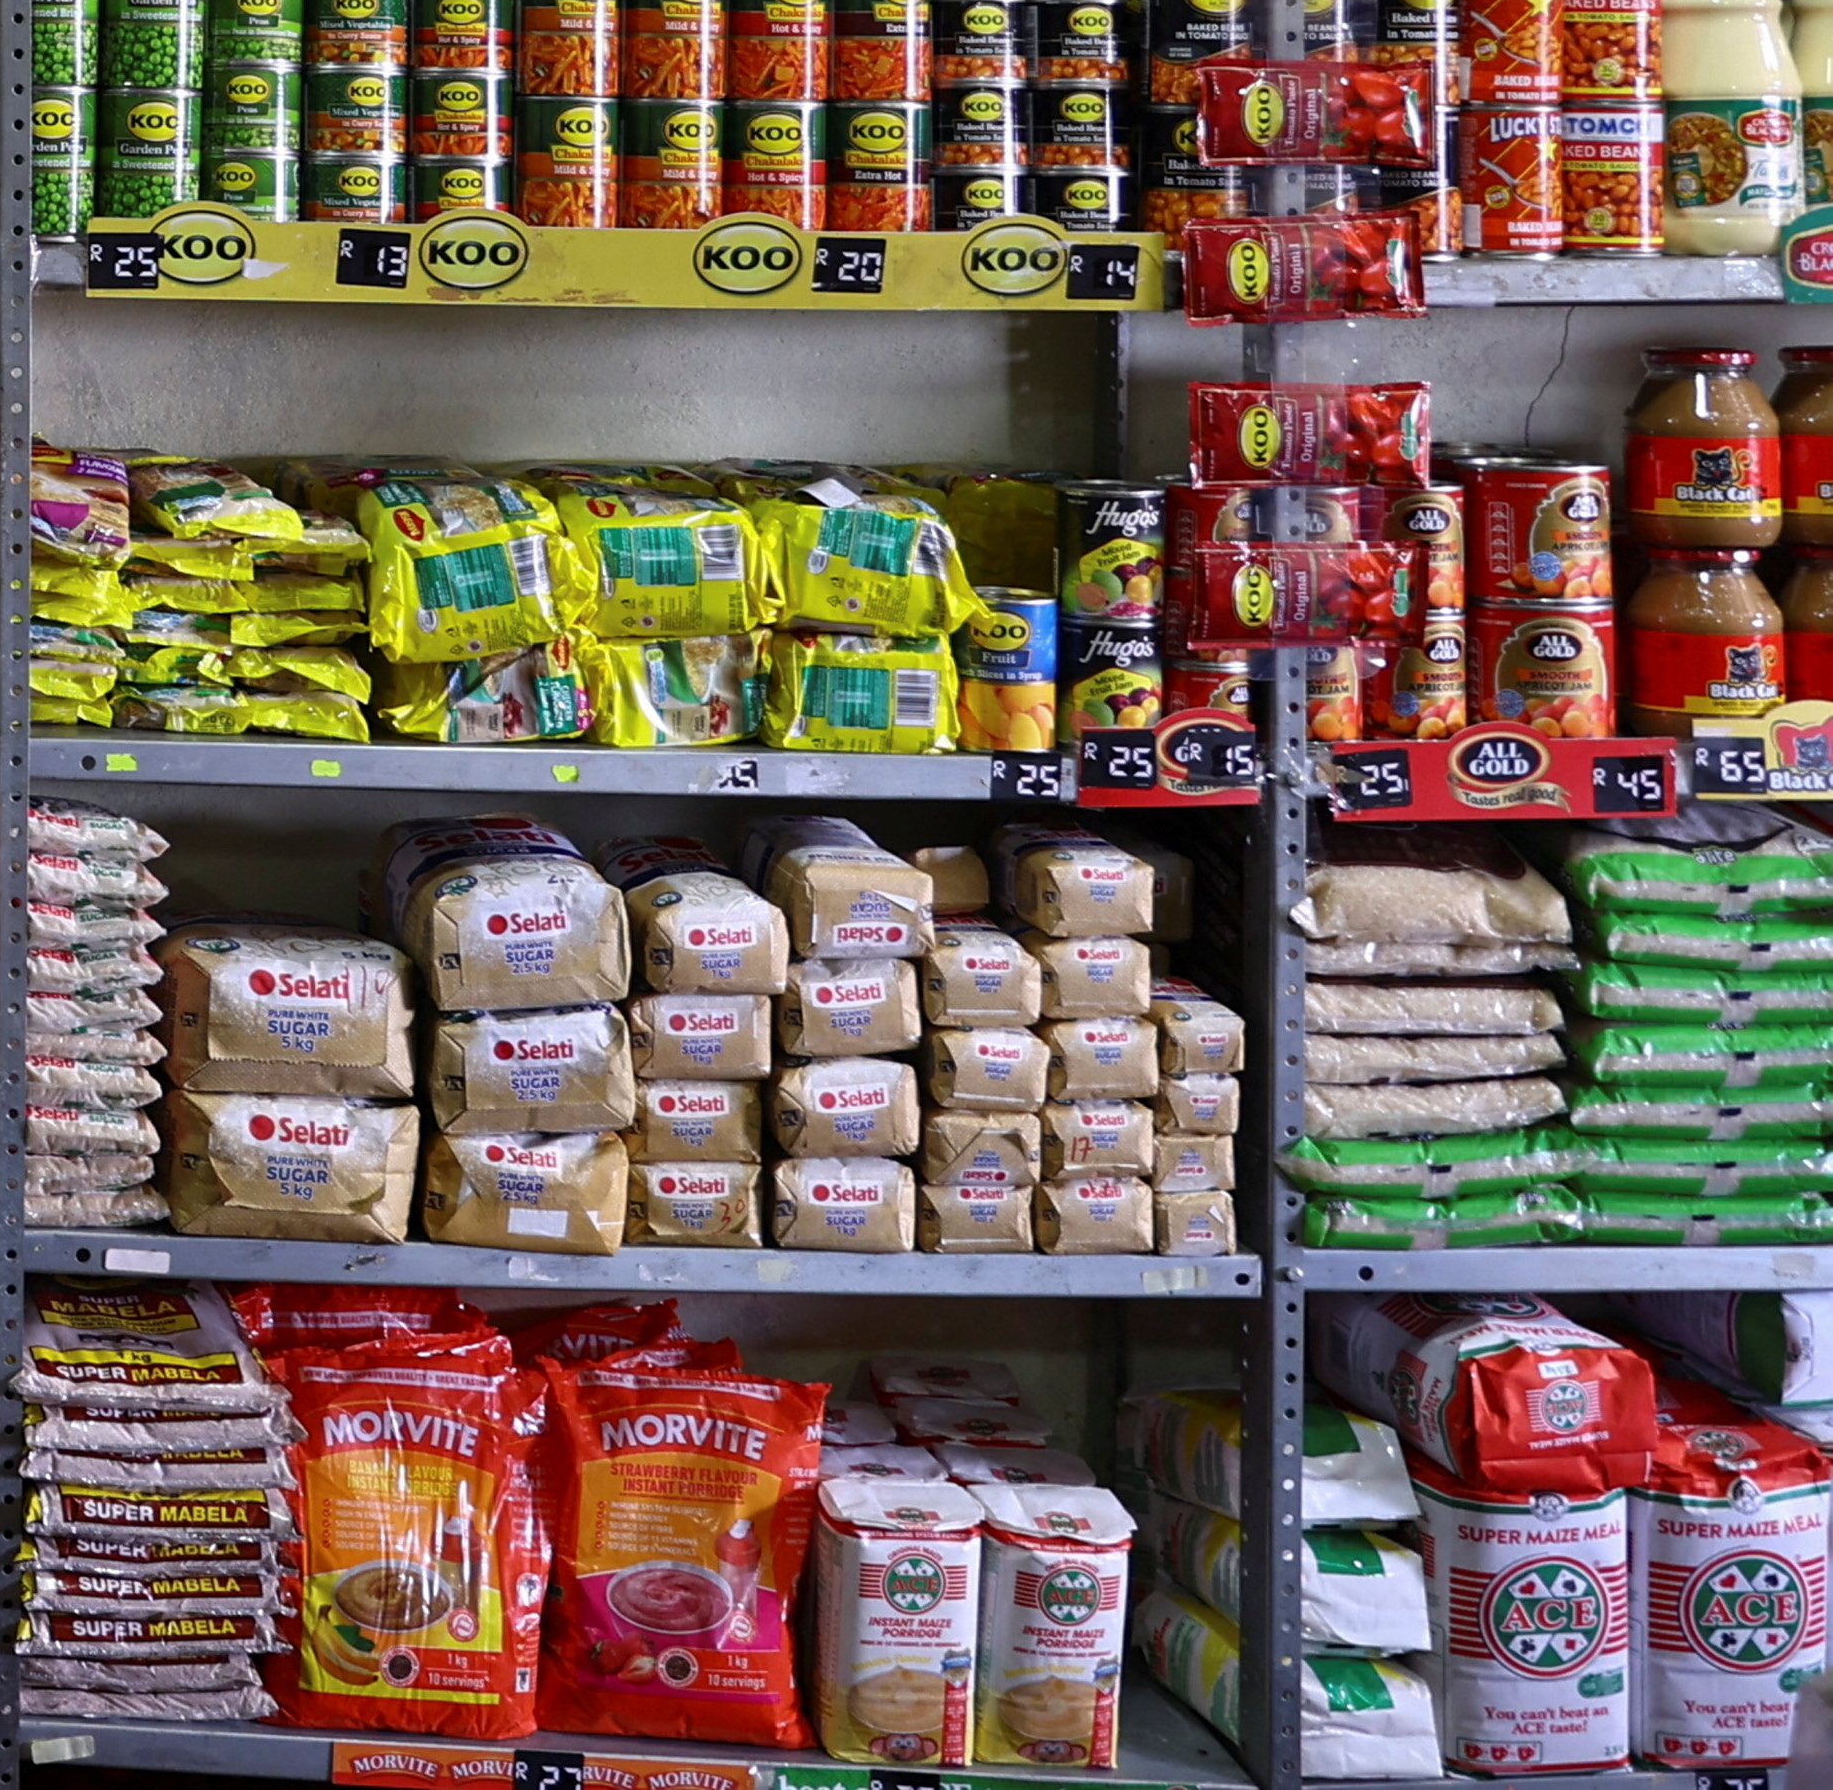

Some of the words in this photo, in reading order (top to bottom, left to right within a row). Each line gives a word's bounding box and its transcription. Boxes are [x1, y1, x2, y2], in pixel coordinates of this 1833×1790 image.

[855, 171, 879, 180] Extra
[882, 171, 902, 181] Hot
[115, 248, 158, 278] 25
[377, 246, 407, 276] 13
[427, 240, 520, 268] KOO
[702, 245, 793, 272] KOO
[970, 247, 1059, 272] KOO
[839, 253, 881, 282] 20
[1105, 258, 1137, 286] 14
[1086, 500, 1160, 535] Hugo's
[980, 652, 1017, 664] Fruit
[1478, 742, 1522, 759] ALL
[1469, 759, 1529, 776] GOLD
[1720, 751, 1764, 782] 65
[1017, 764, 1059, 796] 25
[1617, 769, 1661, 800] 45
[277, 973, 351, 1000] Selati
[268, 1009, 291, 1021] PURE
[293, 1010, 329, 1021] WHITE
[268, 1019, 330, 1037] SUGAR
[281, 1035, 291, 1050] 5
[294, 1037, 315, 1053] kg
[832, 1184, 880, 1202] Selati
[323, 1411, 479, 1458] MORVITE
[601, 1414, 767, 1461] MORVITE
[610, 1462, 698, 1482] STRAWBERRY
[701, 1469, 757, 1486] FLAVOUR
[623, 1479, 674, 1493] INSTANT
[677, 1482, 745, 1499] PORRIDGE
[1458, 1523, 1520, 1545] SUPER
[1526, 1525, 1578, 1544] MAIZE
[1580, 1519, 1623, 1542] MEAL
[891, 1575, 939, 1594] ACE
[1502, 1597, 1598, 1631] ACE
[707, 1674, 720, 1689] 10
[722, 1675, 766, 1691] servings
[1484, 1706, 1516, 1723] You
[1518, 1706, 1555, 1721] can't
[1558, 1707, 1588, 1721] beat
[1591, 1708, 1608, 1719] an
[1511, 1720, 1546, 1735] ACE
[1549, 1720, 1588, 1734] taste!
